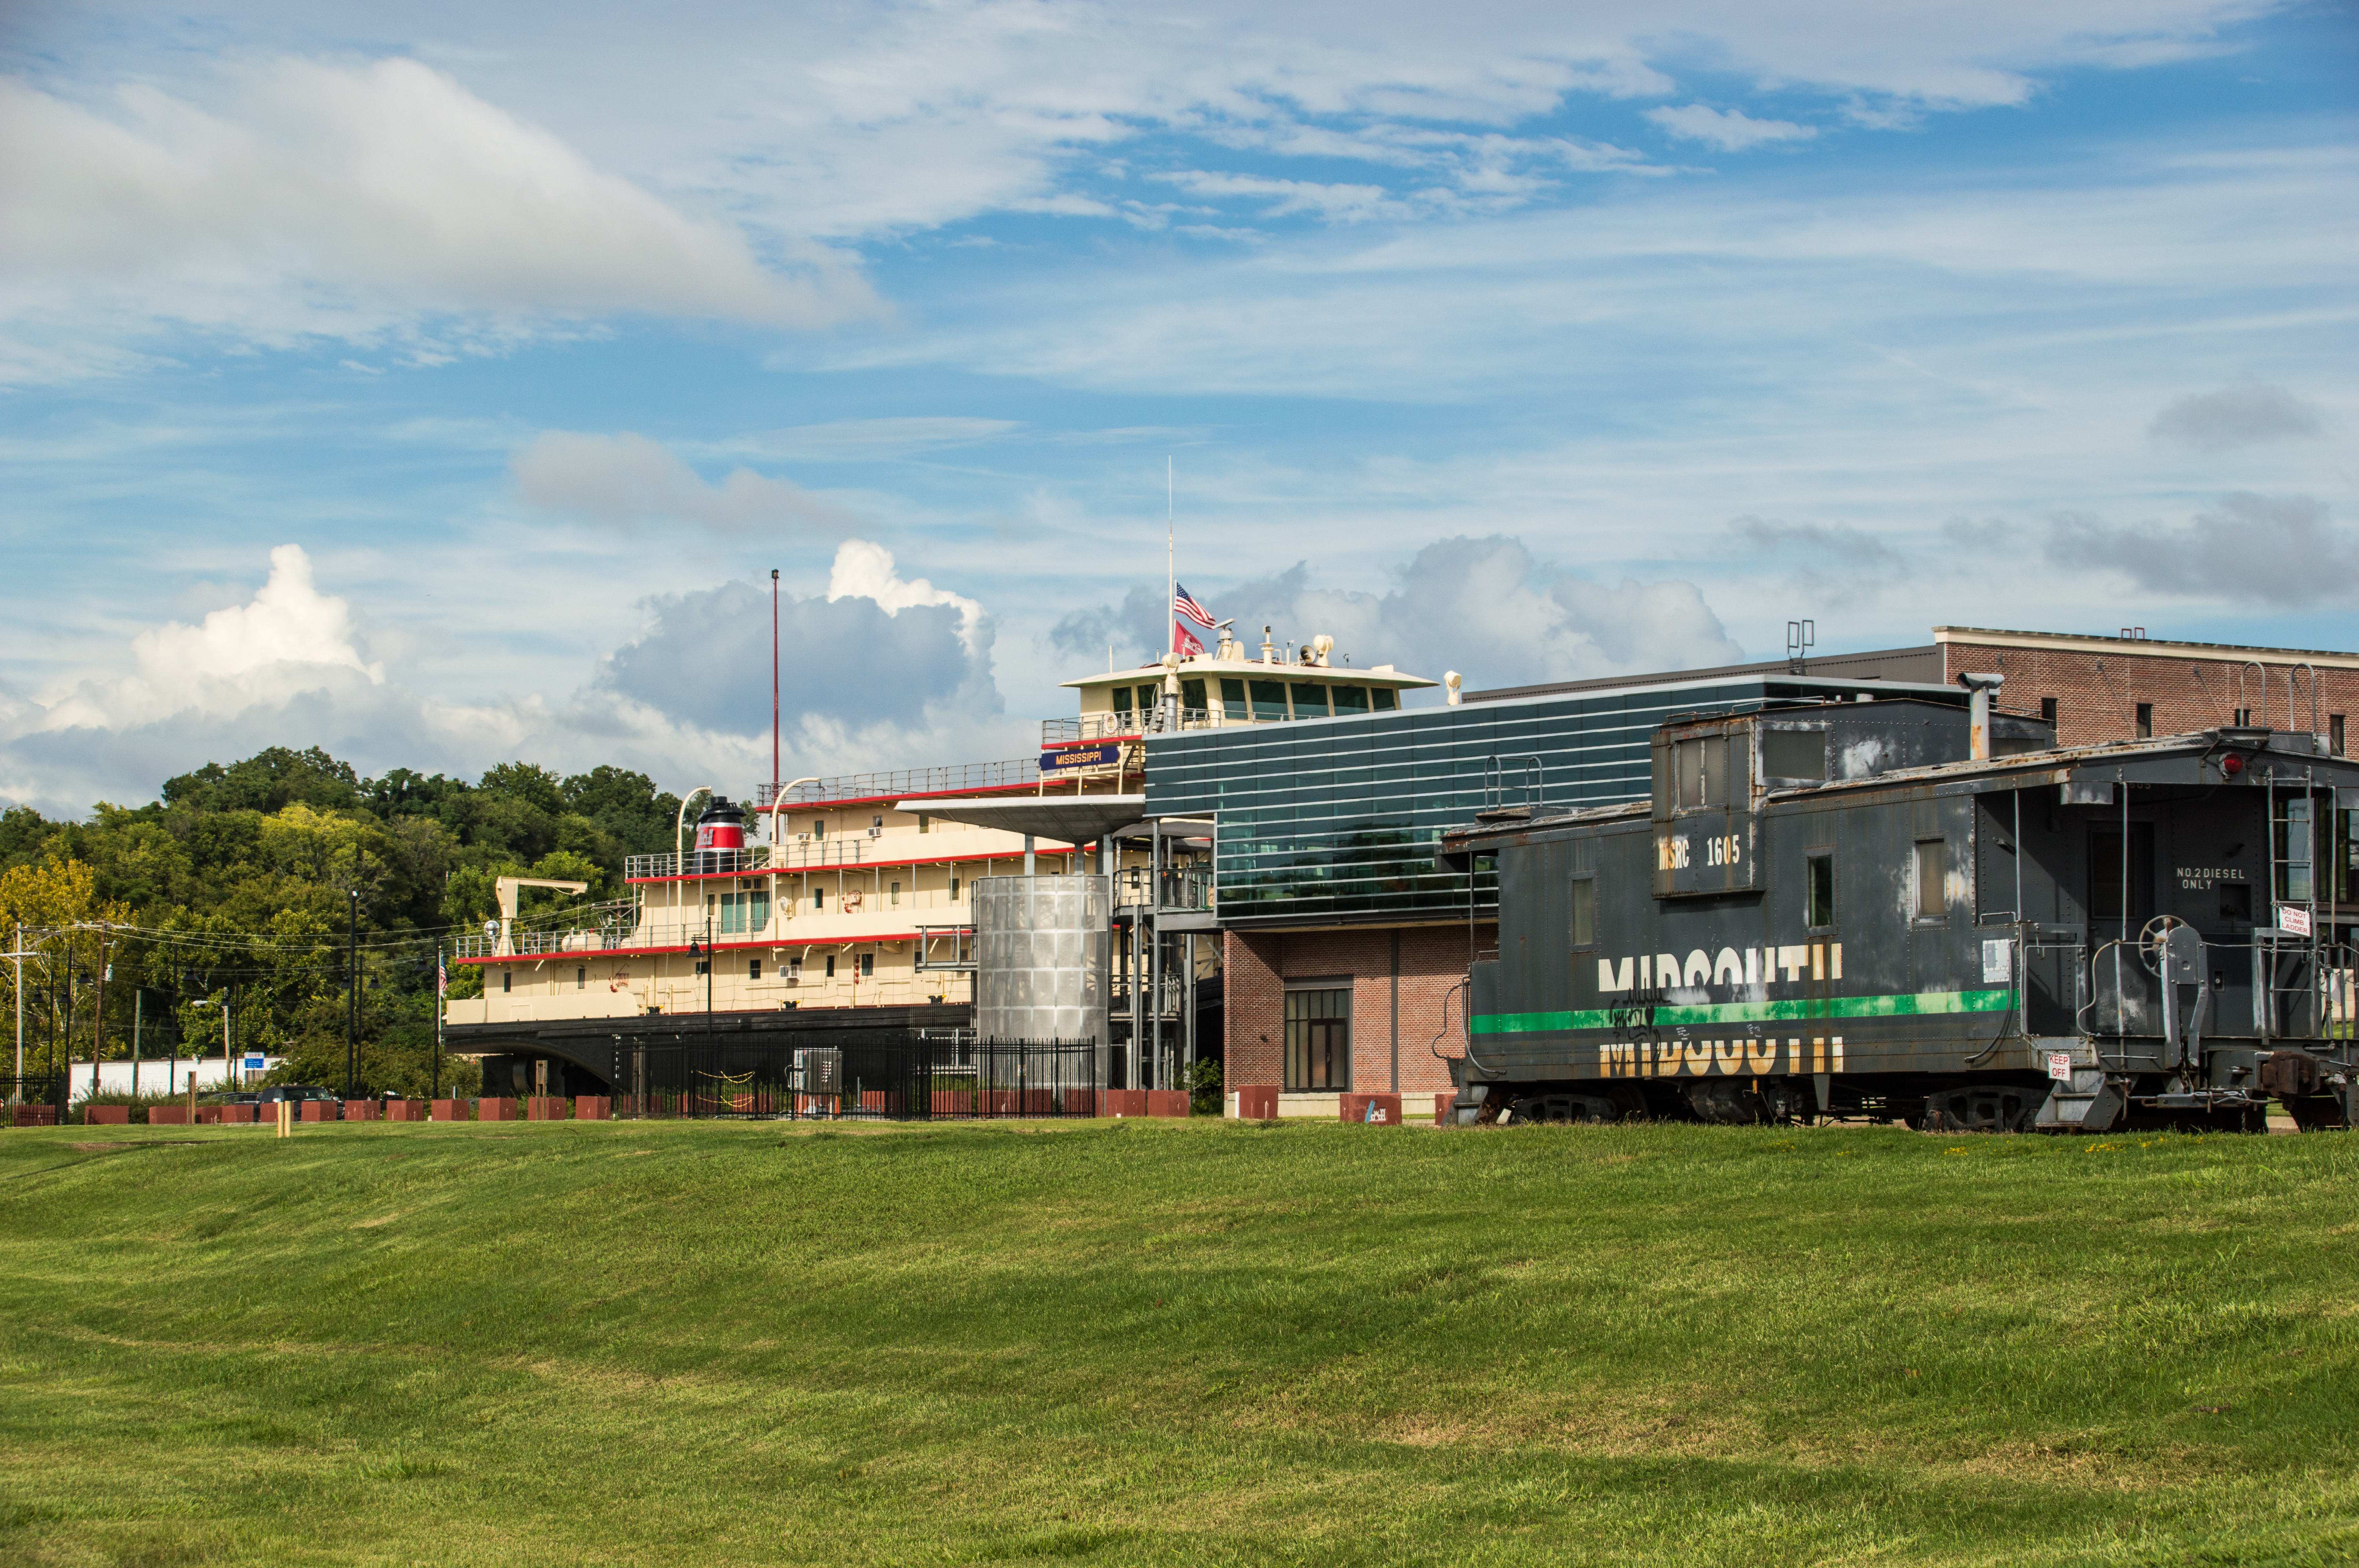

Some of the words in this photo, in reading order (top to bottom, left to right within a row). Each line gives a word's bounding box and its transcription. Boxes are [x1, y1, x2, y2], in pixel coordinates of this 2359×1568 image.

[1056, 751, 1101, 765] MISSISSIPPI
[1659, 839, 1689, 870] MSRC
[1707, 835, 1740, 866] 1605
[2203, 868, 2245, 879] DIESEL
[2183, 879, 2212, 889] ONLY
[2285, 916, 2304, 926] CLIMB
[2282, 922, 2308, 933] LADDER
[2050, 1054, 2068, 1065] KEEP
[2052, 1067, 2066, 1078] OFF
